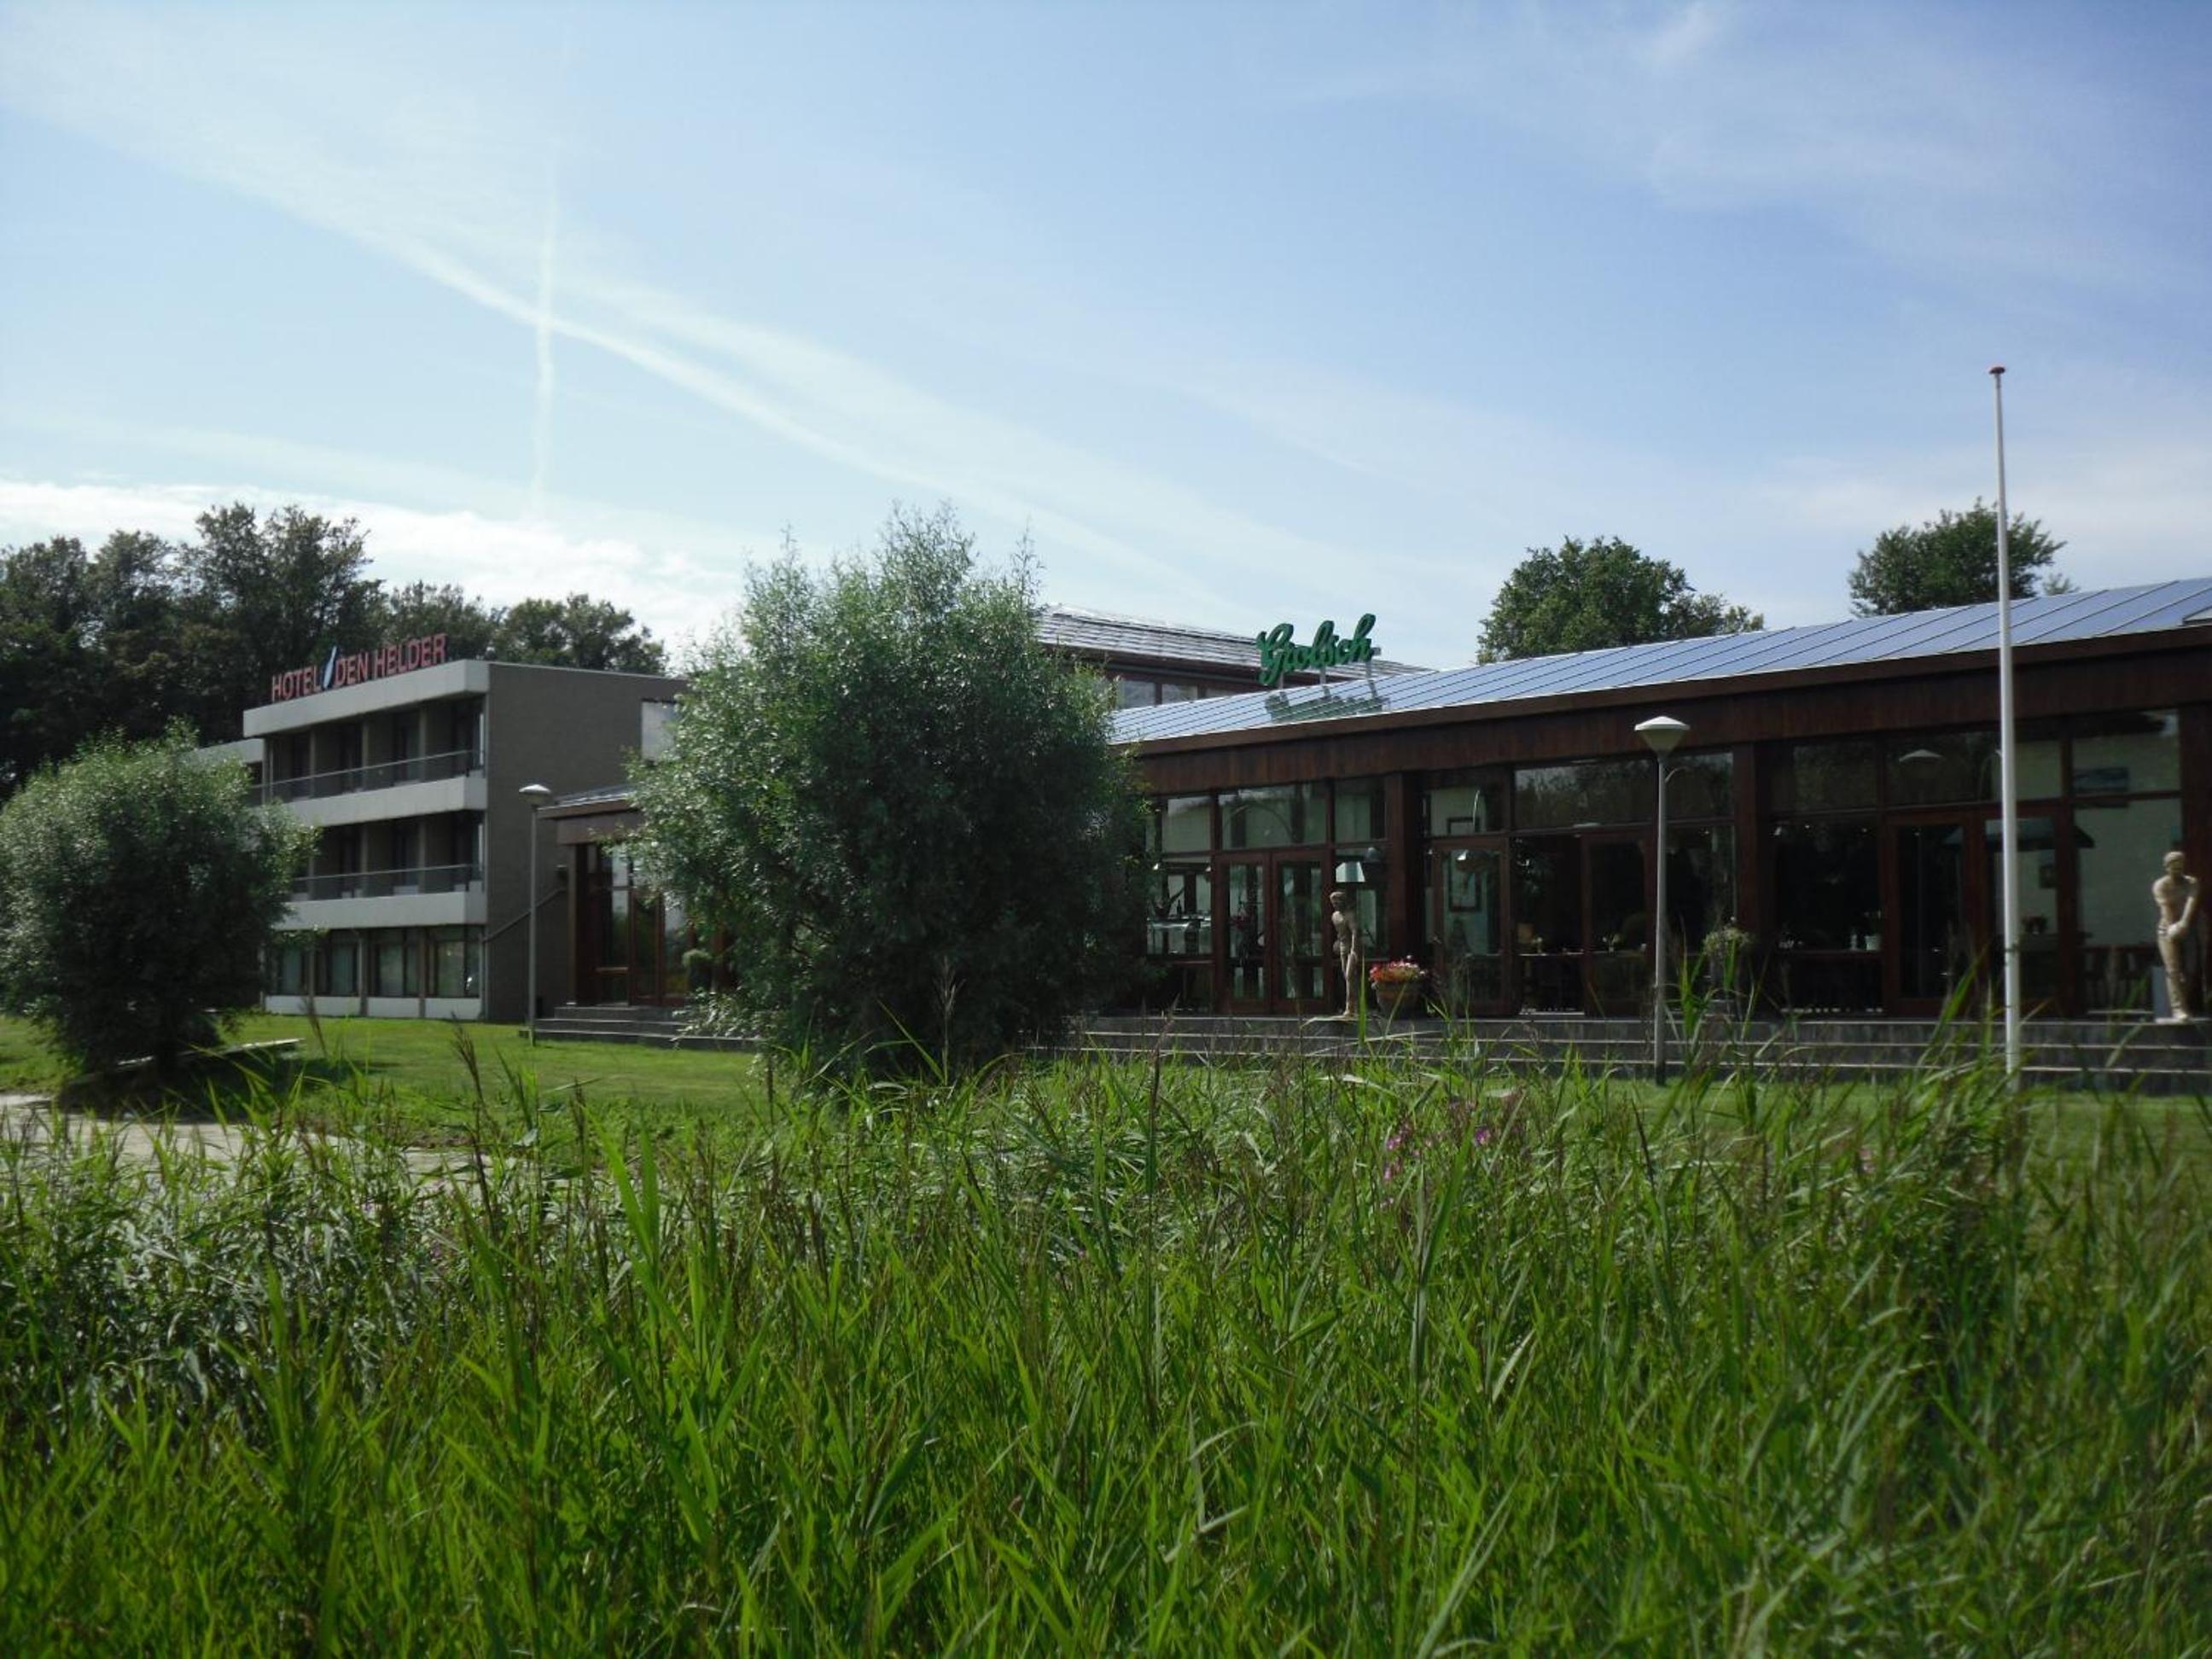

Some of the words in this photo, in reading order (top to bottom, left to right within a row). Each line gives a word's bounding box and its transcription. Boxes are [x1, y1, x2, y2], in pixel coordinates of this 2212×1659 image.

[271, 664, 323, 702] HOTEL
[333, 652, 368, 687] DEN
[373, 632, 447, 679] HELDER
[1256, 613, 1377, 687] Grolsch
